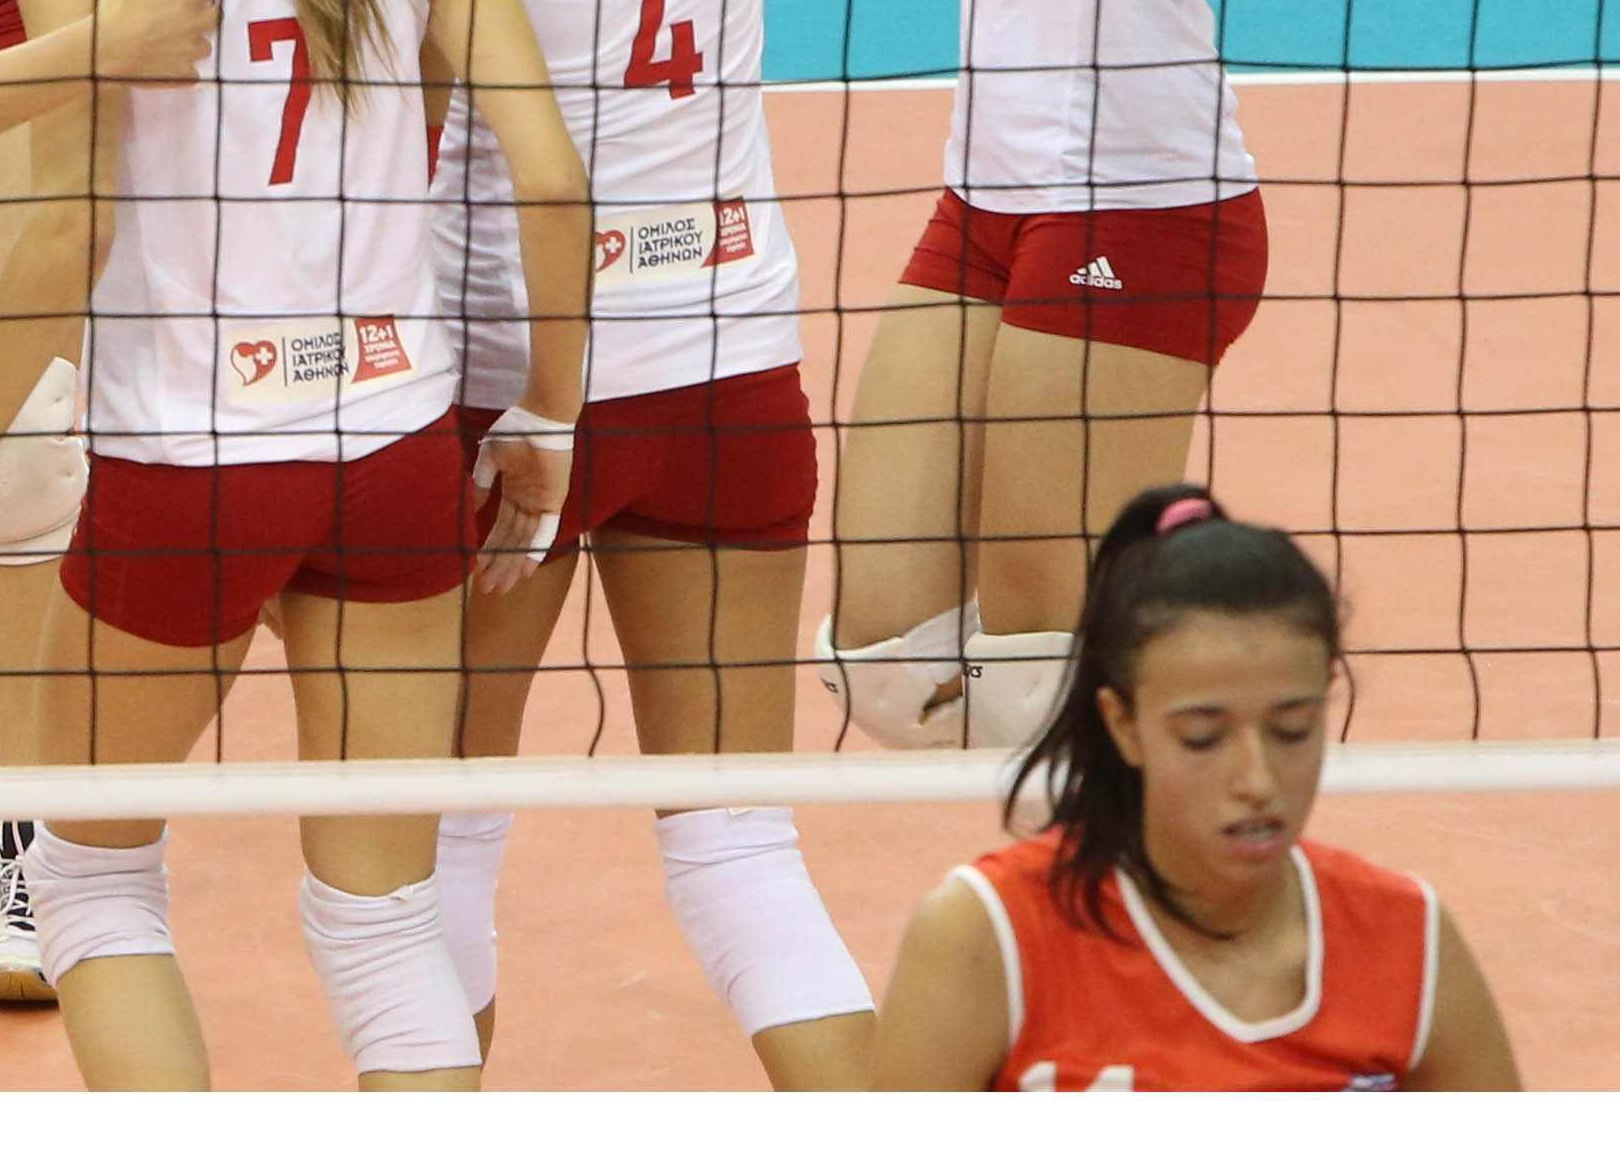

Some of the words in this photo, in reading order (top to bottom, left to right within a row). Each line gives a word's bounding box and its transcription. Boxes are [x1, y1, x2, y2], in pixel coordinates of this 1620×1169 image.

[248, 16, 313, 186] 7
[637, 218, 696, 239] ΟΜΙΛΟΣ
[638, 231, 704, 255] ΙΑΤΡΙΚΟΥ
[637, 247, 703, 269] ΑΘΗΝΩΝ
[1068, 272, 1123, 290] adidas
[359, 325, 394, 344] 12+1
